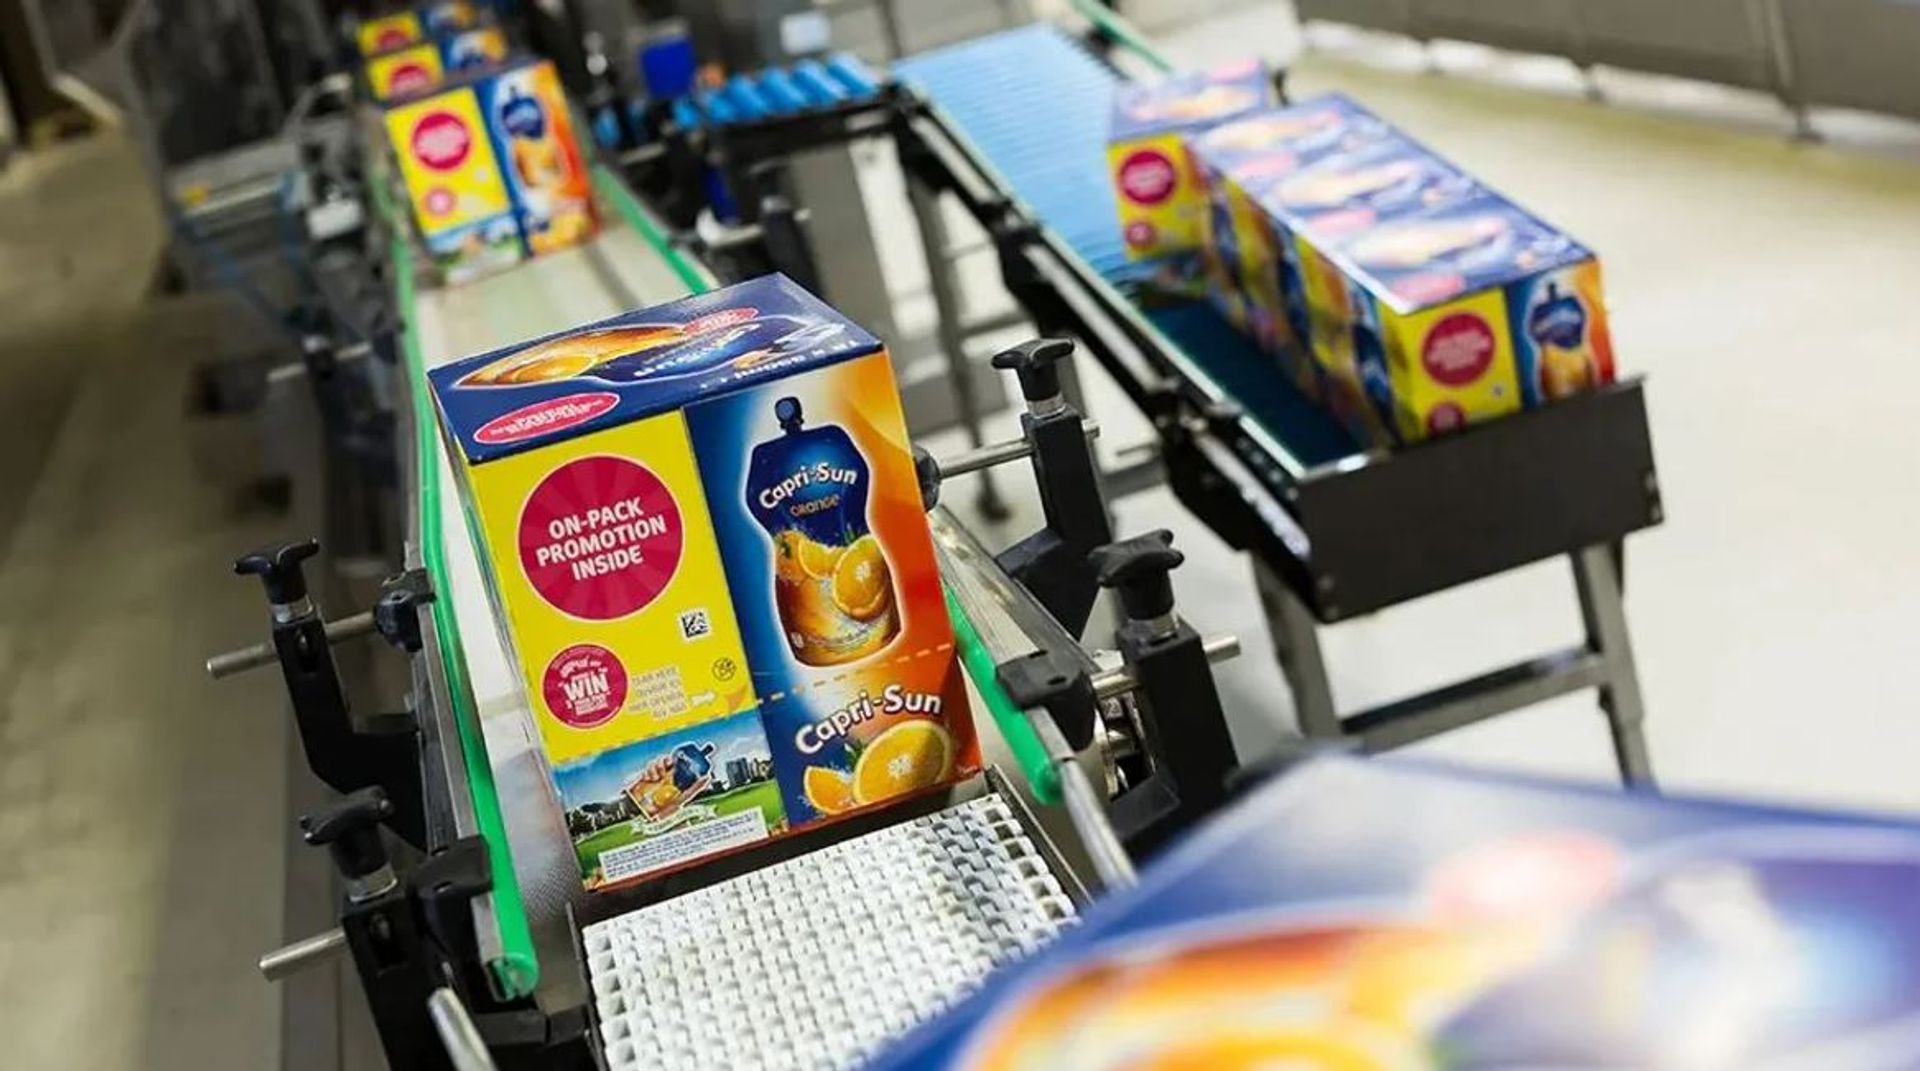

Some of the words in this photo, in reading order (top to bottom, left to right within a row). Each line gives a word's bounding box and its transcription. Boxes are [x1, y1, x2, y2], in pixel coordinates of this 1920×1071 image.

[759, 462, 858, 509] Capri-Sun
[548, 496, 644, 540] ON-PACK
[535, 514, 668, 568] PROMOTION
[571, 545, 644, 581] INSIDE
[563, 672, 609, 701] WIN
[794, 684, 942, 755] Capri-Sun
